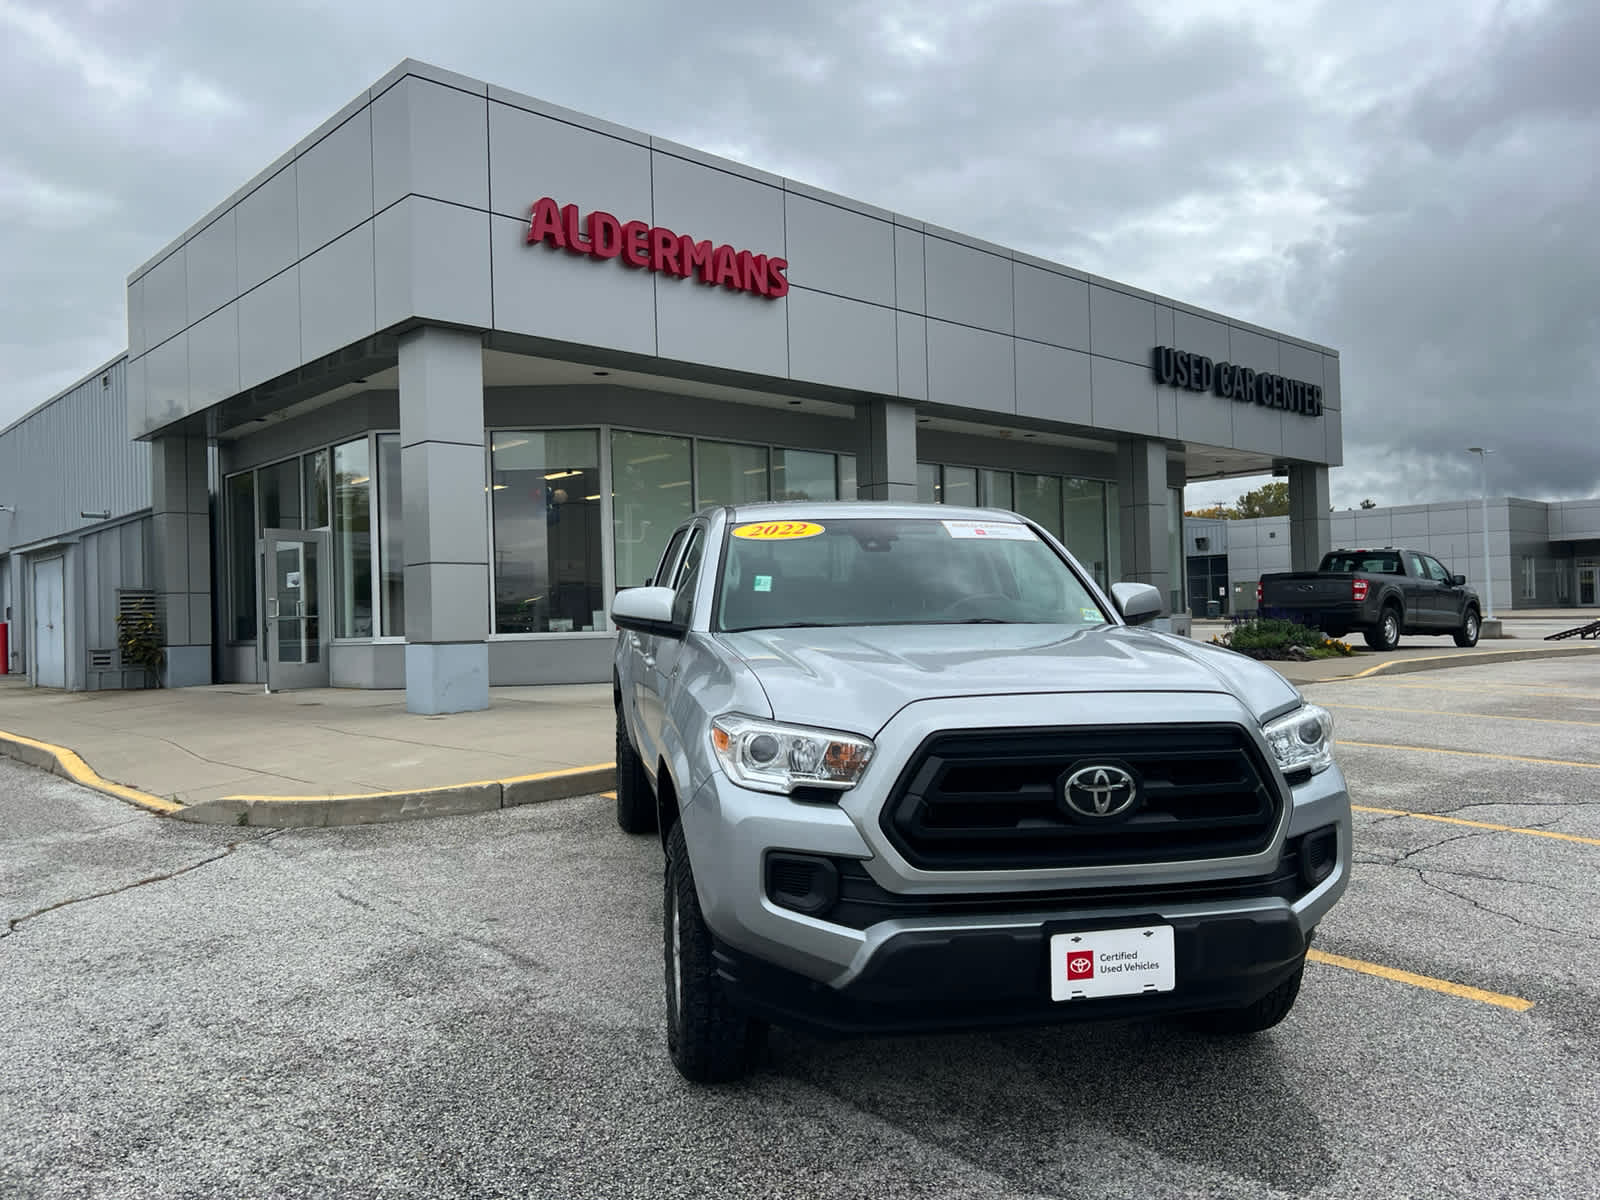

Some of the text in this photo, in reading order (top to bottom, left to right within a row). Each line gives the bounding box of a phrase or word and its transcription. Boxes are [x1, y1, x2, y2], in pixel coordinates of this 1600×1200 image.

[527, 197, 789, 298] ALDERMANS
[1154, 346, 1323, 417] USED CAR CENTER
[748, 523, 808, 537] 2022
[1099, 951, 1138, 962] Certified
[1100, 961, 1160, 974] Used Vehicles
